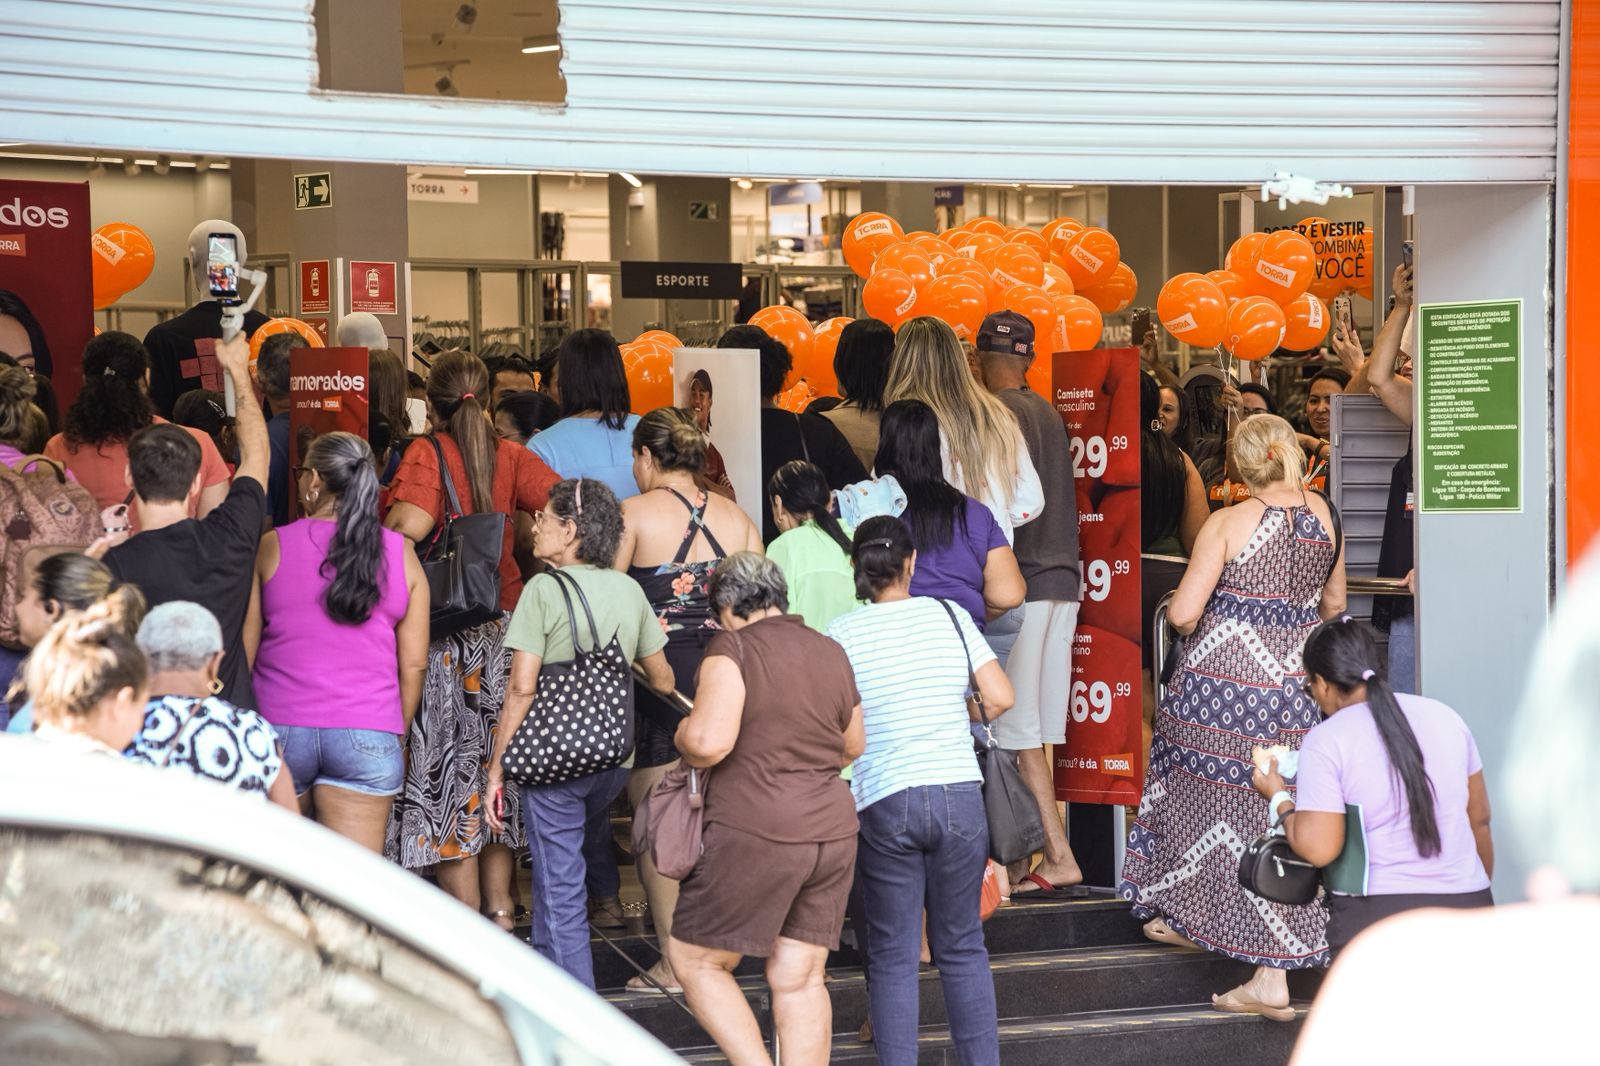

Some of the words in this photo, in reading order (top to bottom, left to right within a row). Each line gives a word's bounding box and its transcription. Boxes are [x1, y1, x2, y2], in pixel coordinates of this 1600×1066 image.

[411, 184, 445, 195] TORRA
[1310, 219, 1318, 238] É
[1321, 222, 1365, 236] VESTIR
[1310, 239, 1365, 255] OMBINA
[1074, 248, 1096, 270] TORRA
[1260, 264, 1289, 282] TORRA
[1316, 253, 1365, 280] VOCÊ
[656, 274, 710, 287] ESPORTE
[1057, 388, 1094, 400] Camiseta
[1057, 400, 1095, 412] masculina
[1078, 511, 1104, 525] jeans
[1058, 758, 1078, 768] amou?
[1080, 758, 1084, 768] é
[1086, 758, 1098, 769] da
[1104, 760, 1130, 770] TORRA
